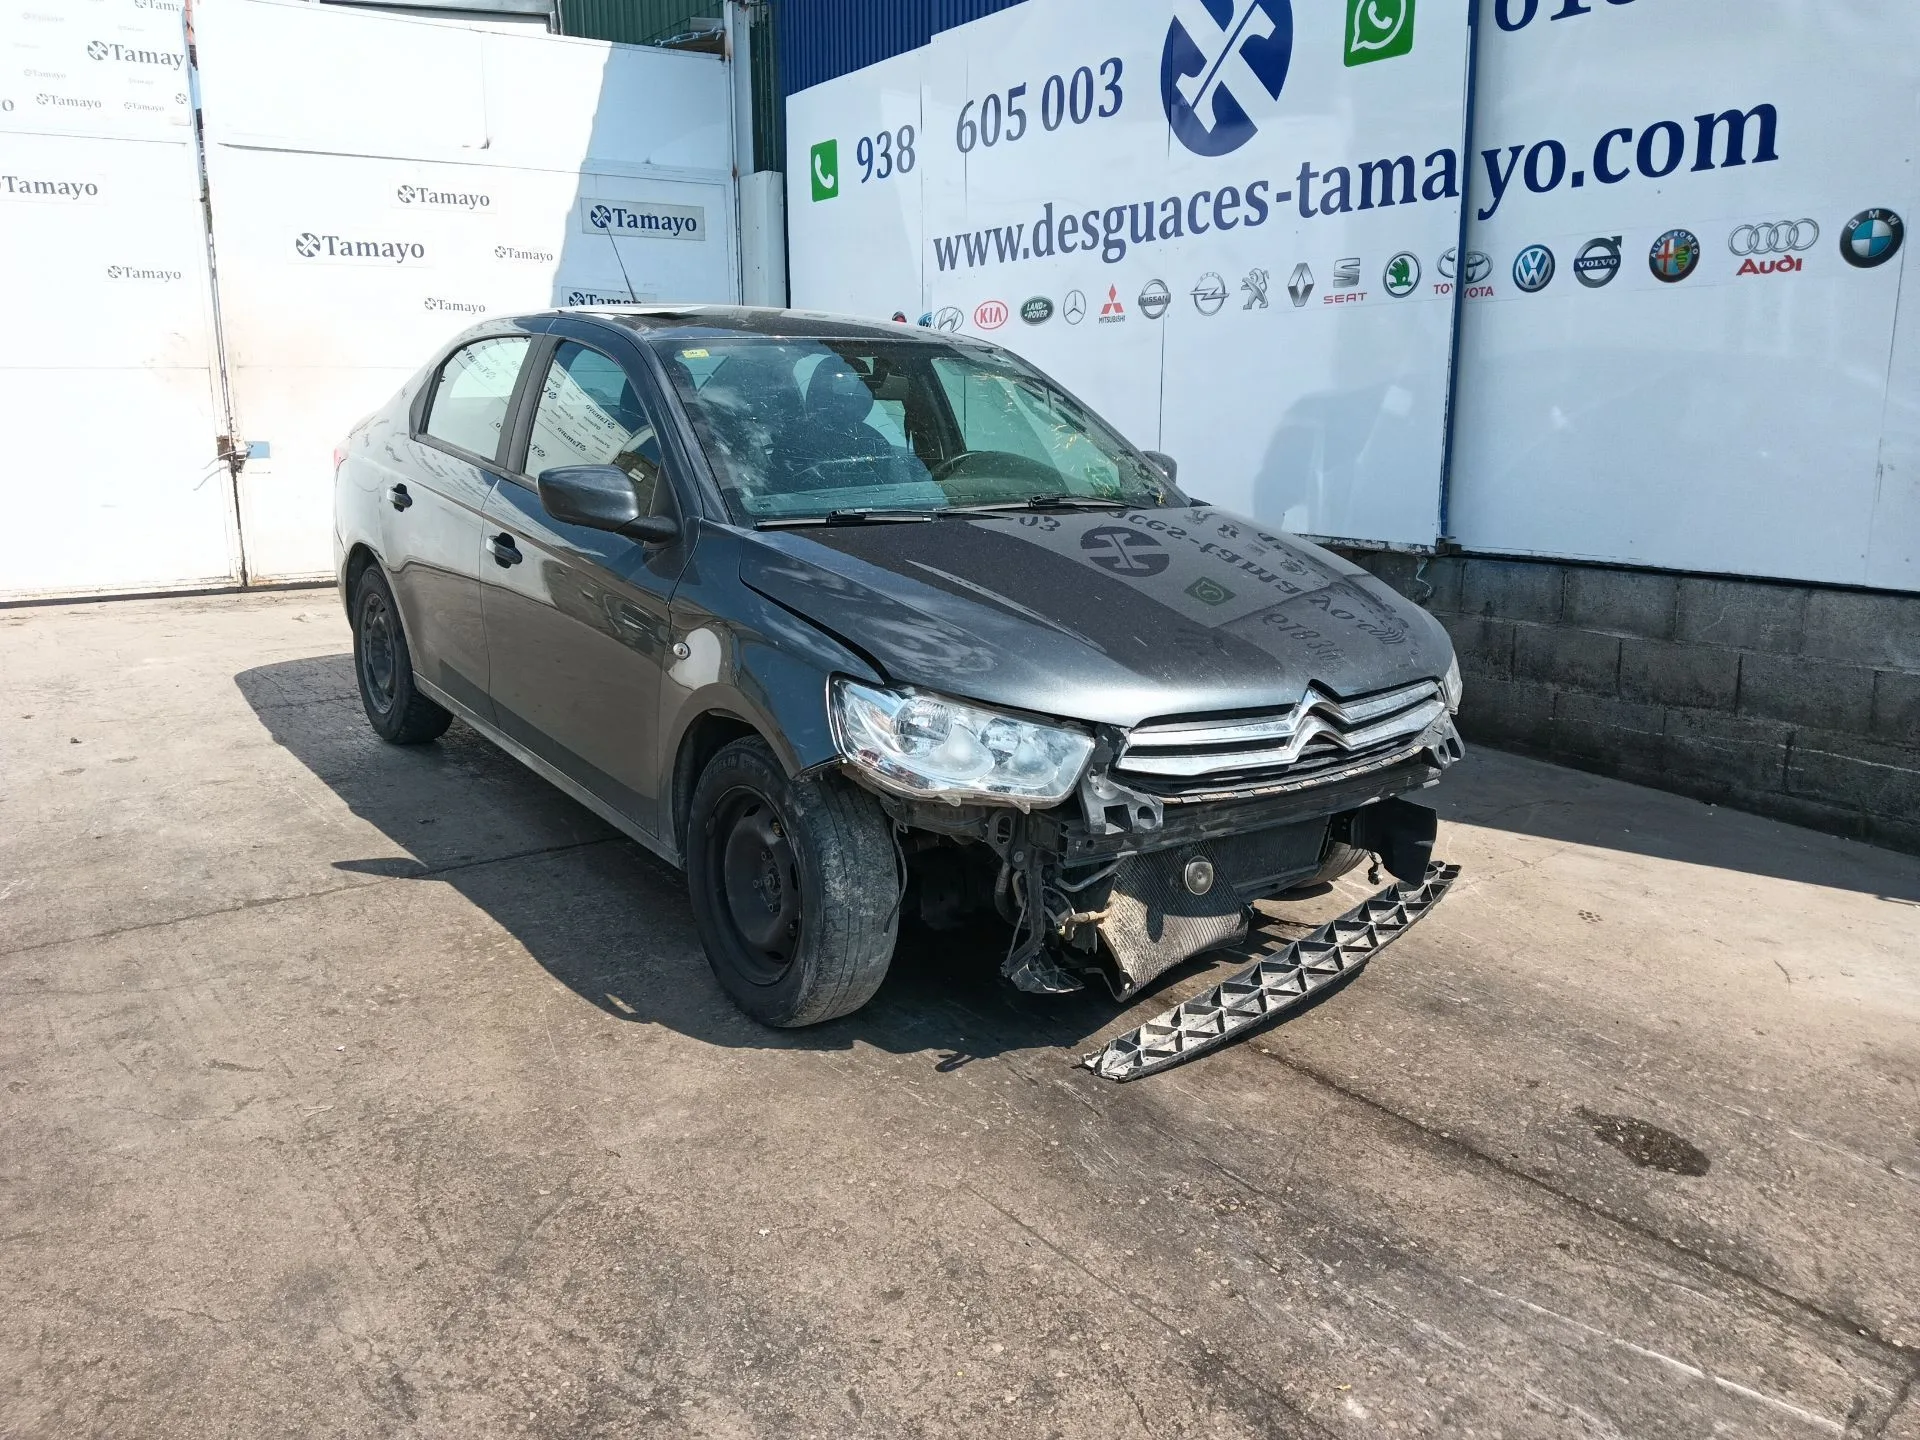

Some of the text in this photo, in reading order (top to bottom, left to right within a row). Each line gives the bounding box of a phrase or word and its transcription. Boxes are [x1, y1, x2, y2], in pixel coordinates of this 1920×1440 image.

[109, 43, 184, 70] Tamay
[50, 94, 102, 110] Tamayo
[133, 102, 165, 113] Tamayo
[856, 56, 1124, 184] 938 605 003
[2, 175, 99, 200] Tamayo
[416, 186, 490, 208] Tamayo
[612, 207, 697, 236] Tamayo
[1847, 209, 1901, 231] BMW
[322, 235, 425, 263] Tamayo
[1650, 231, 1699, 259] ALFA ROMEO
[506, 247, 554, 263] Tamayo
[1577, 256, 1618, 271] VOLVO
[1736, 255, 1803, 276] Audi
[122, 266, 182, 282] Tamayo
[1141, 295, 1169, 304] NISSAN
[1323, 292, 1368, 304] SEAT
[437, 299, 486, 315] Tamayo
[1026, 302, 1044, 311] LAND
[1027, 309, 1048, 319] ROVER
[979, 307, 1003, 324] KIA
[1098, 315, 1126, 324] MITSUBISHI
